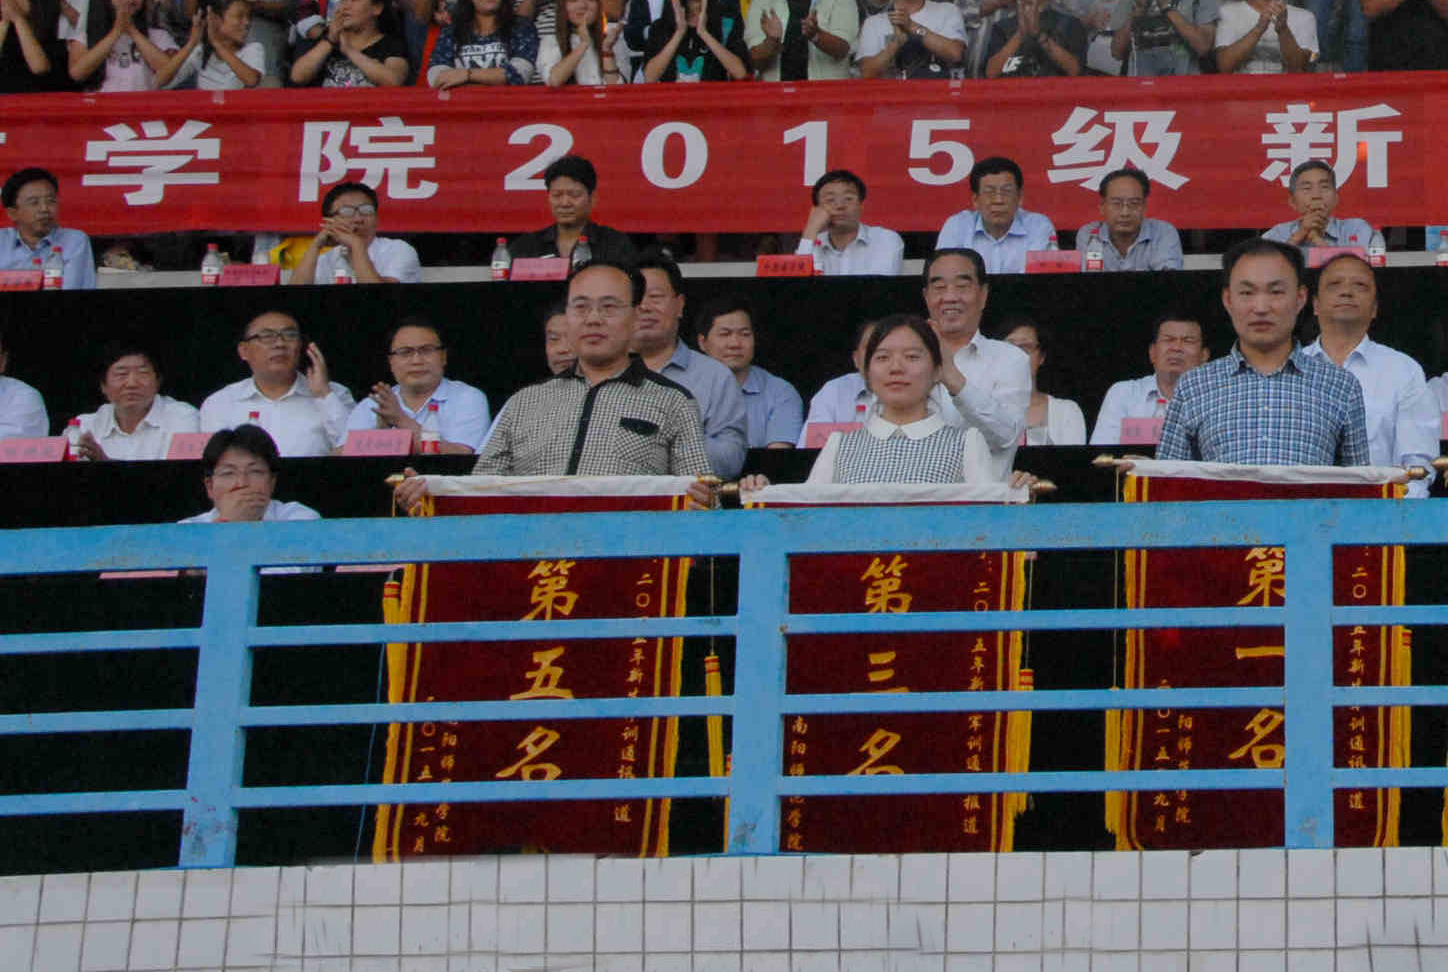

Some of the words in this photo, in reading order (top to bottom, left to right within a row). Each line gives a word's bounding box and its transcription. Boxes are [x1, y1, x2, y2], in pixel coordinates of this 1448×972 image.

[495, 560, 580, 781] 第五名
[846, 554, 913, 776] 第三名
[1227, 547, 1286, 769] 第一名
